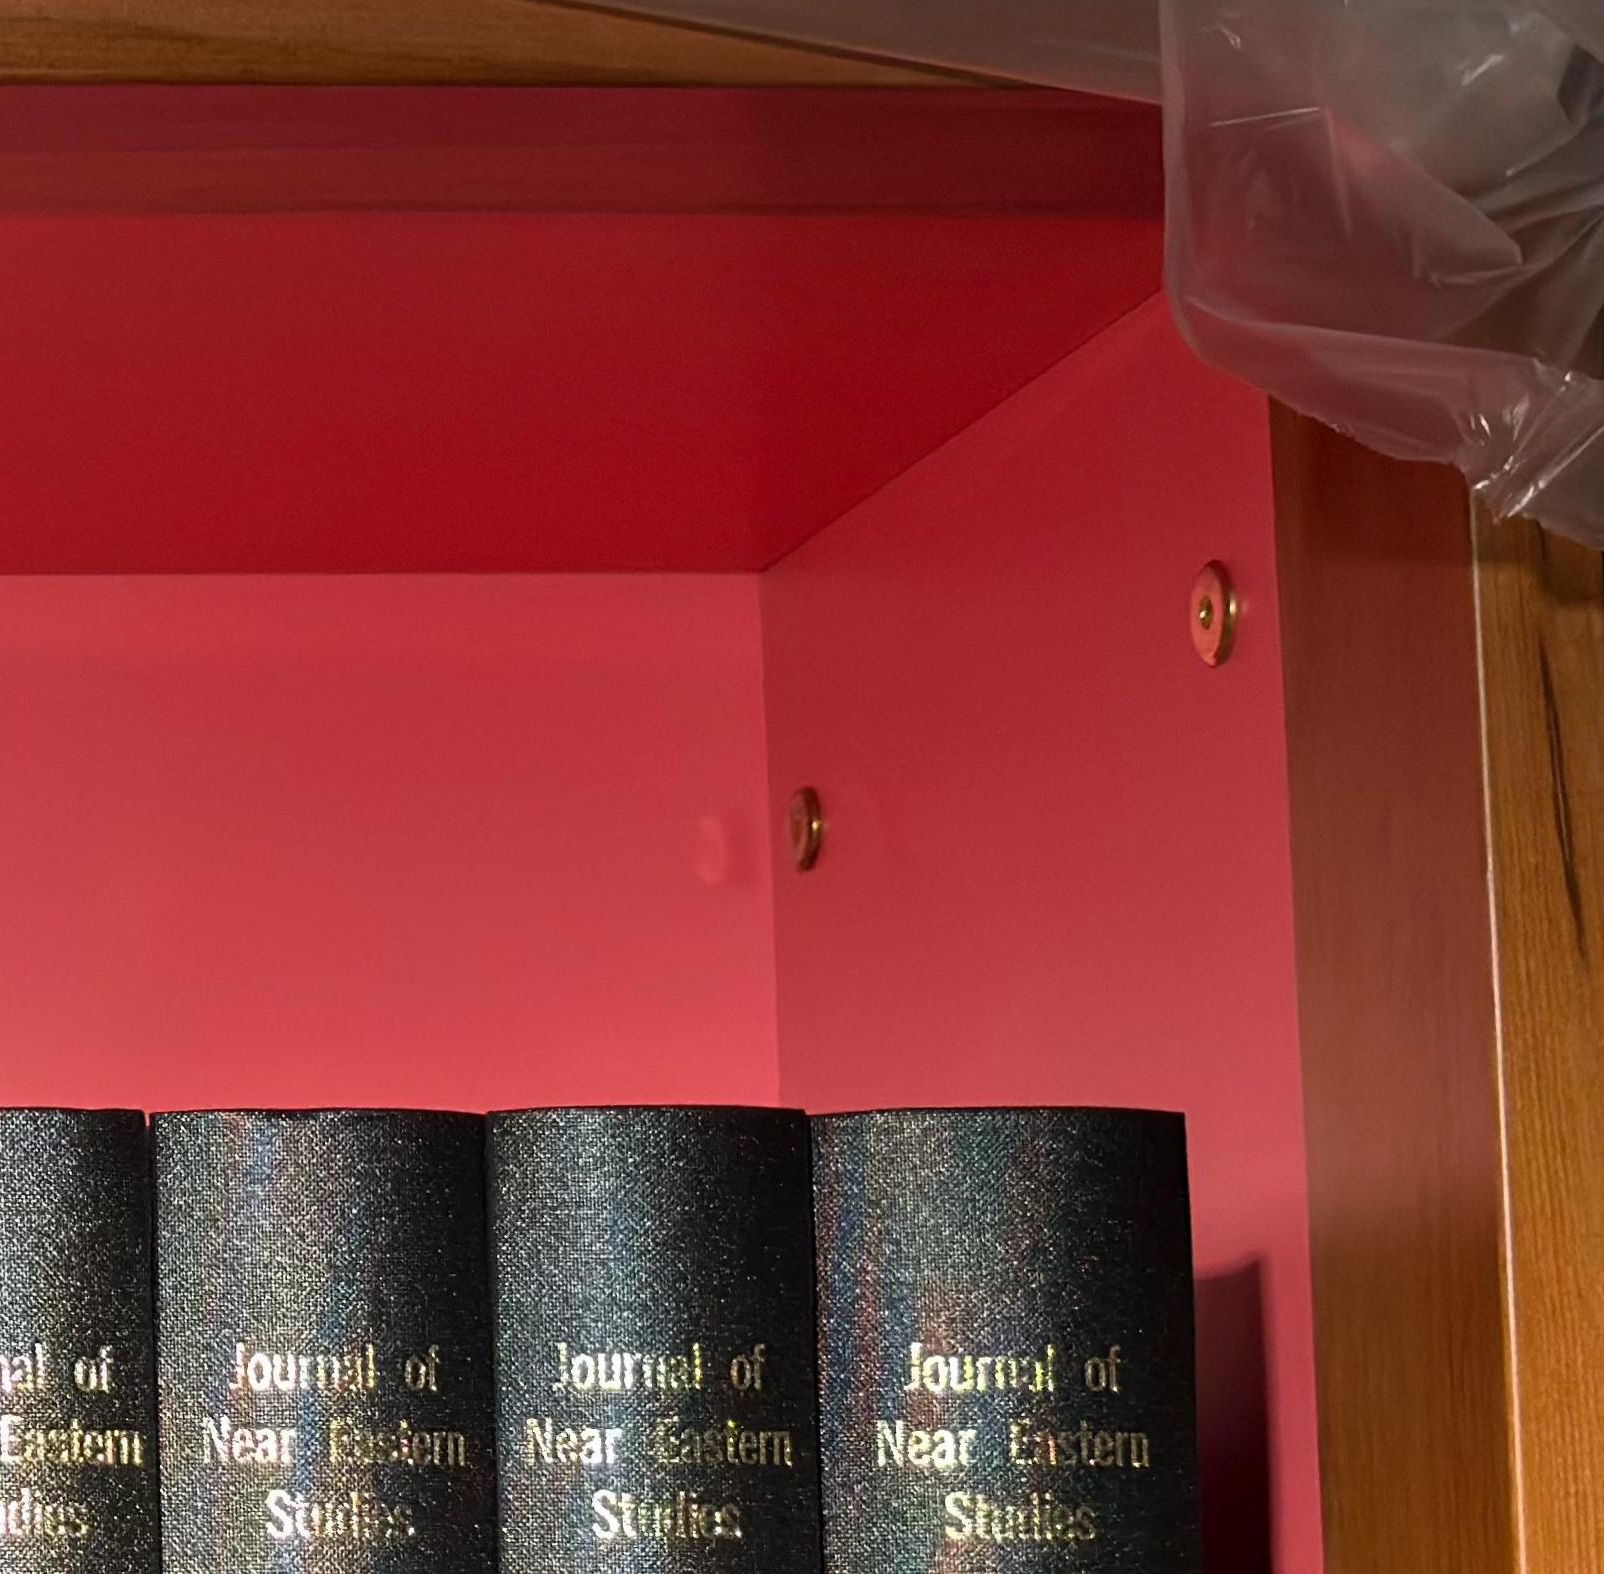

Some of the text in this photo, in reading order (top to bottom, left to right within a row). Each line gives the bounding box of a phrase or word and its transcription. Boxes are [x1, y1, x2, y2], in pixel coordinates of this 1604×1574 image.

[73, 1346, 114, 1394] of
[229, 1343, 441, 1394] Journal of
[552, 1341, 766, 1392] Journal of
[904, 1342, 1122, 1393] Journal of
[203, 1415, 467, 1468] Near Eastern
[525, 1416, 793, 1469] Near Eastern
[876, 1419, 1150, 1471] Near Eastern
[264, 1489, 416, 1541] Studies
[592, 1488, 744, 1541] Studies
[943, 1490, 1097, 1543] Studies
